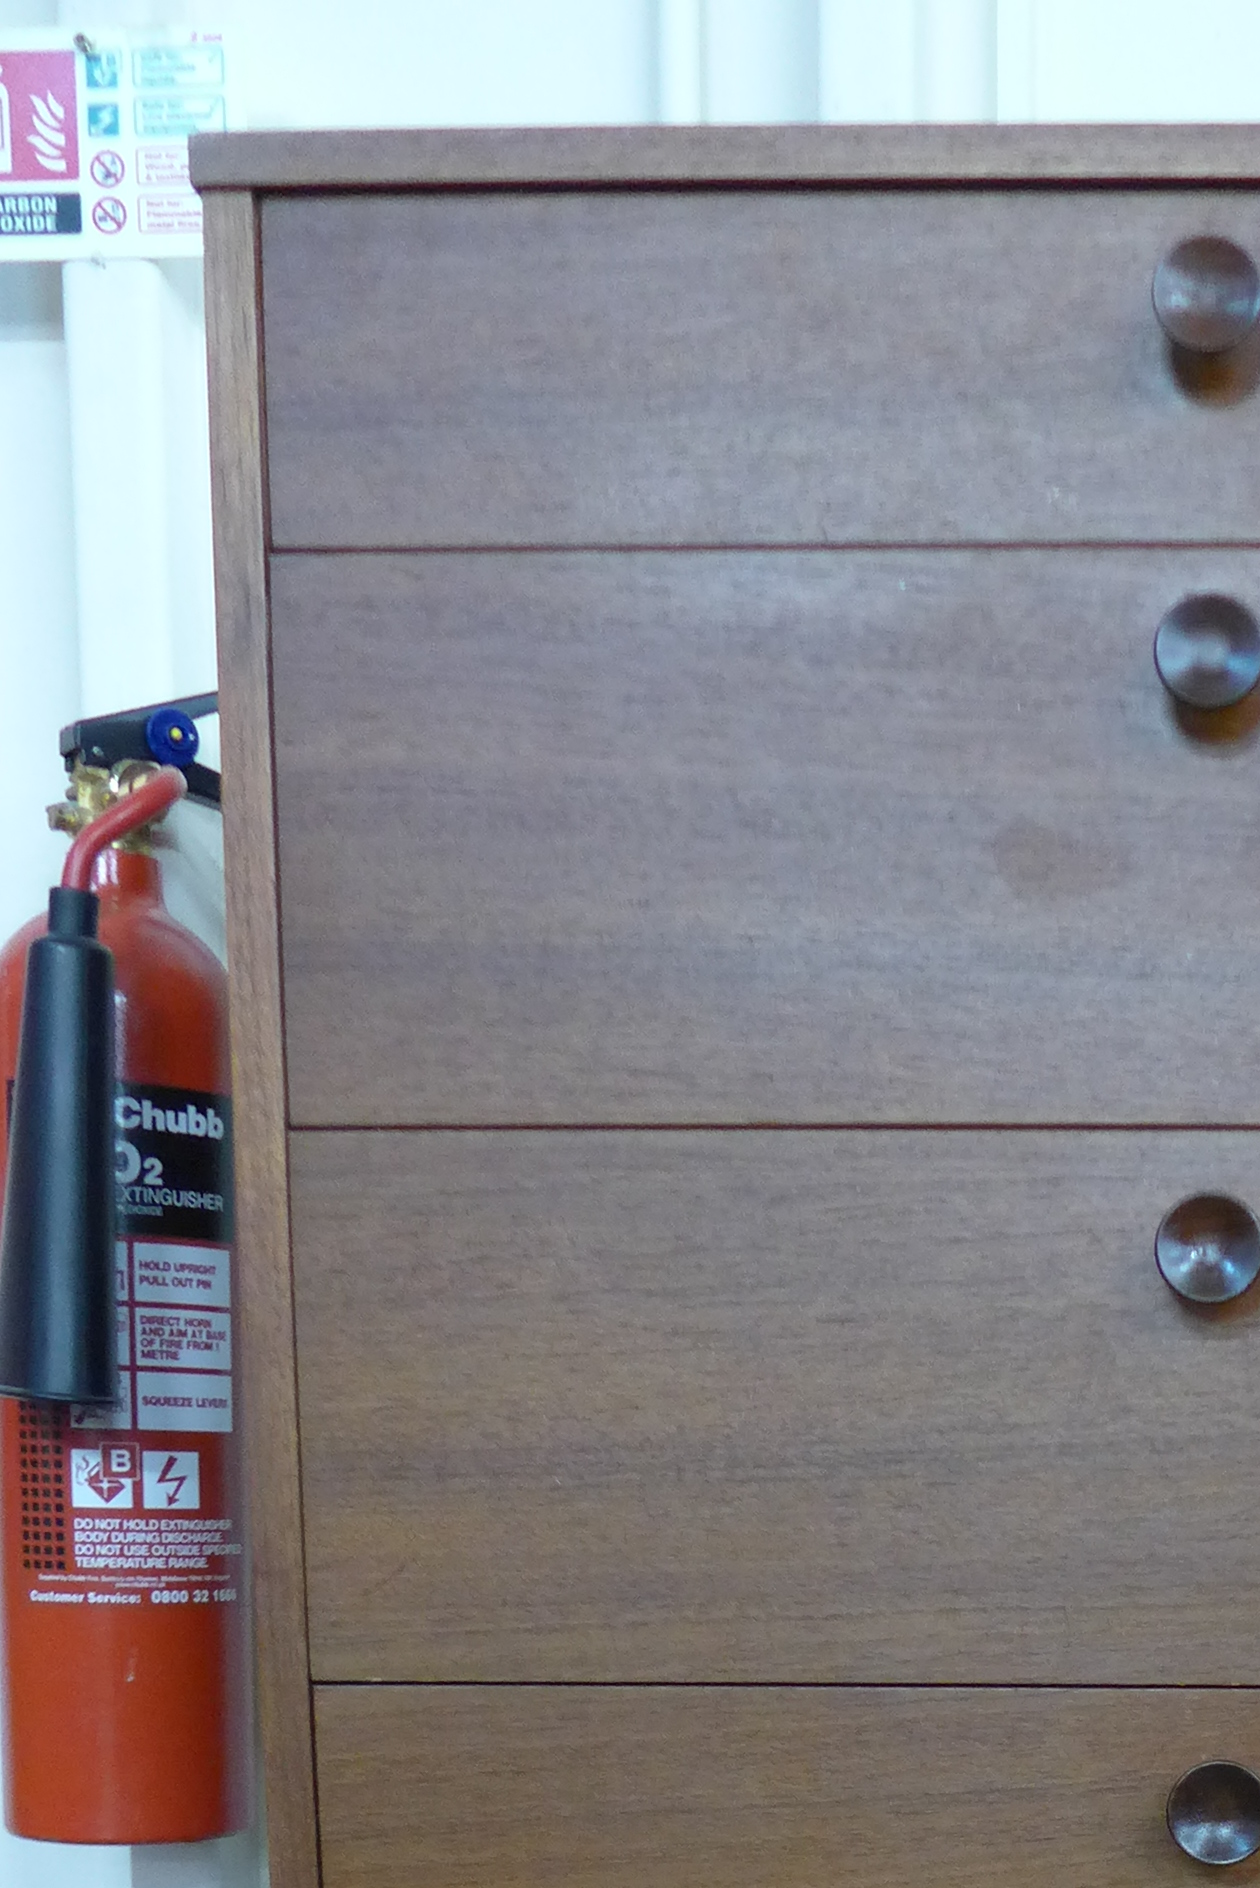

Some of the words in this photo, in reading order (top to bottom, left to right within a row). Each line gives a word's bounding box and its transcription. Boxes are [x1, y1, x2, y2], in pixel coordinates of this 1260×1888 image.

[115, 1096, 224, 1140] Chubb
[138, 1260, 171, 1272] HOLD
[173, 1263, 216, 1275] UPRIGHT
[138, 1275, 169, 1287] PULL
[171, 1277, 194, 1288] OUT
[196, 1278, 212, 1290] PIN
[140, 1315, 180, 1327] DIRECT
[184, 1318, 212, 1329] HORN
[140, 1327, 165, 1337] AND
[168, 1328, 187, 1338] AIM
[191, 1329, 203, 1339] AT
[140, 1338, 156, 1348] OF
[159, 1338, 183, 1349] FIRE
[186, 1340, 213, 1351] FROM
[140, 1349, 180, 1361] METRE
[141, 1395, 193, 1408] SQUEEZE
[110, 1449, 131, 1473] B
[73, 1518, 93, 1530] DO
[94, 1519, 120, 1530] NOT
[122, 1519, 159, 1530] HOLD
[74, 1531, 109, 1542] BODY
[111, 1532, 160, 1543] DURING
[74, 1544, 93, 1555] DO
[95, 1544, 121, 1556] NOT
[123, 1545, 150, 1556] USE
[151, 1545, 200, 1556] OUTSIDE
[75, 1557, 167, 1569] TEMPERATURE
[29, 1589, 85, 1603] Customer
[150, 1590, 189, 1604] 0800
[192, 1589, 209, 1603] 32
